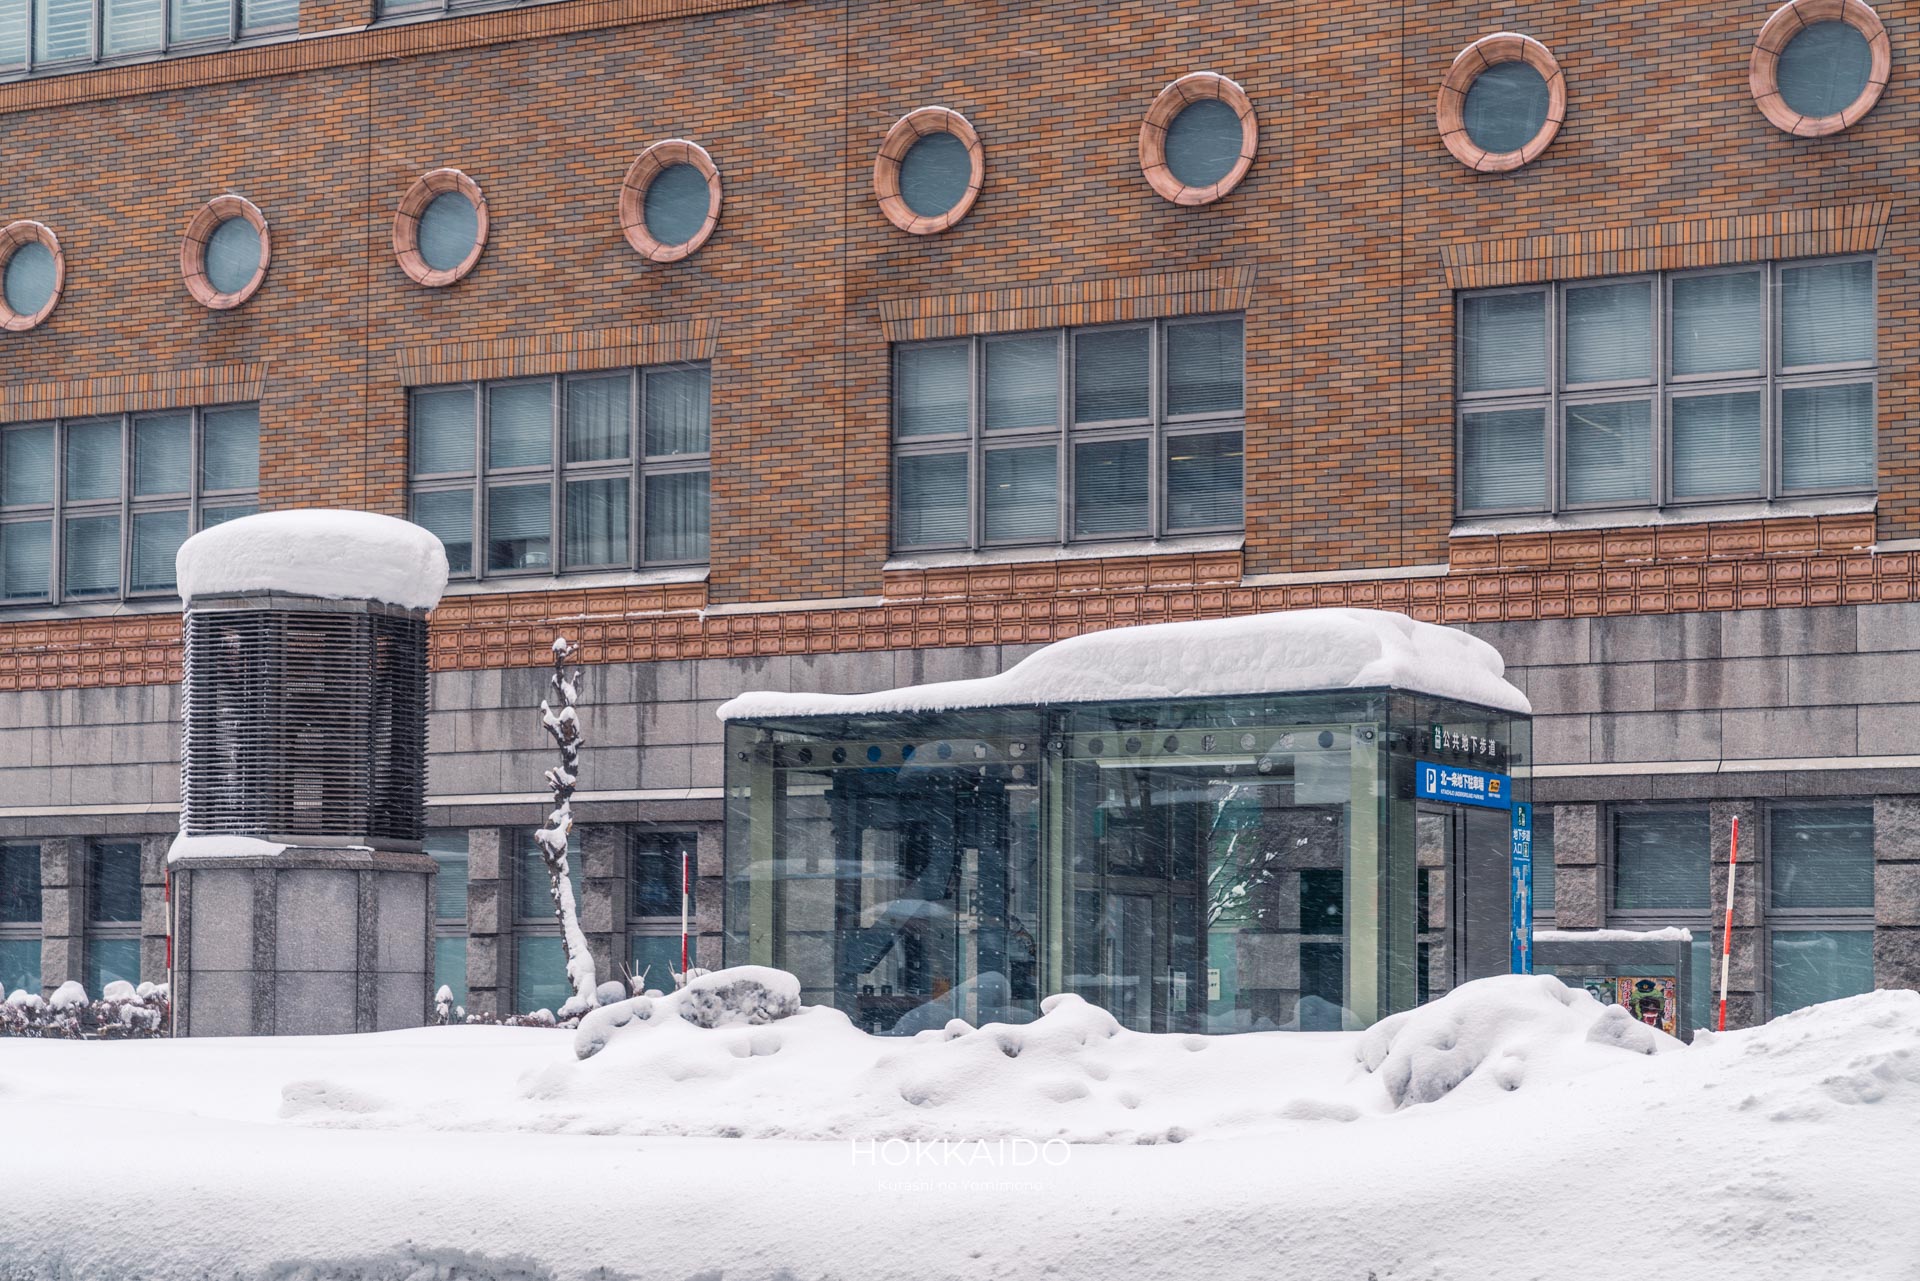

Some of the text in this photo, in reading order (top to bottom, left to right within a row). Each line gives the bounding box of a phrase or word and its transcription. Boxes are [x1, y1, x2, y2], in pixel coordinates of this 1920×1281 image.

[1442, 730, 1495, 756] 公共地下歩道
[1440, 770, 1484, 791] 北一条地下駐車場
[1513, 828, 1531, 842] 地下歩道
[1513, 842, 1522, 854] 入口
